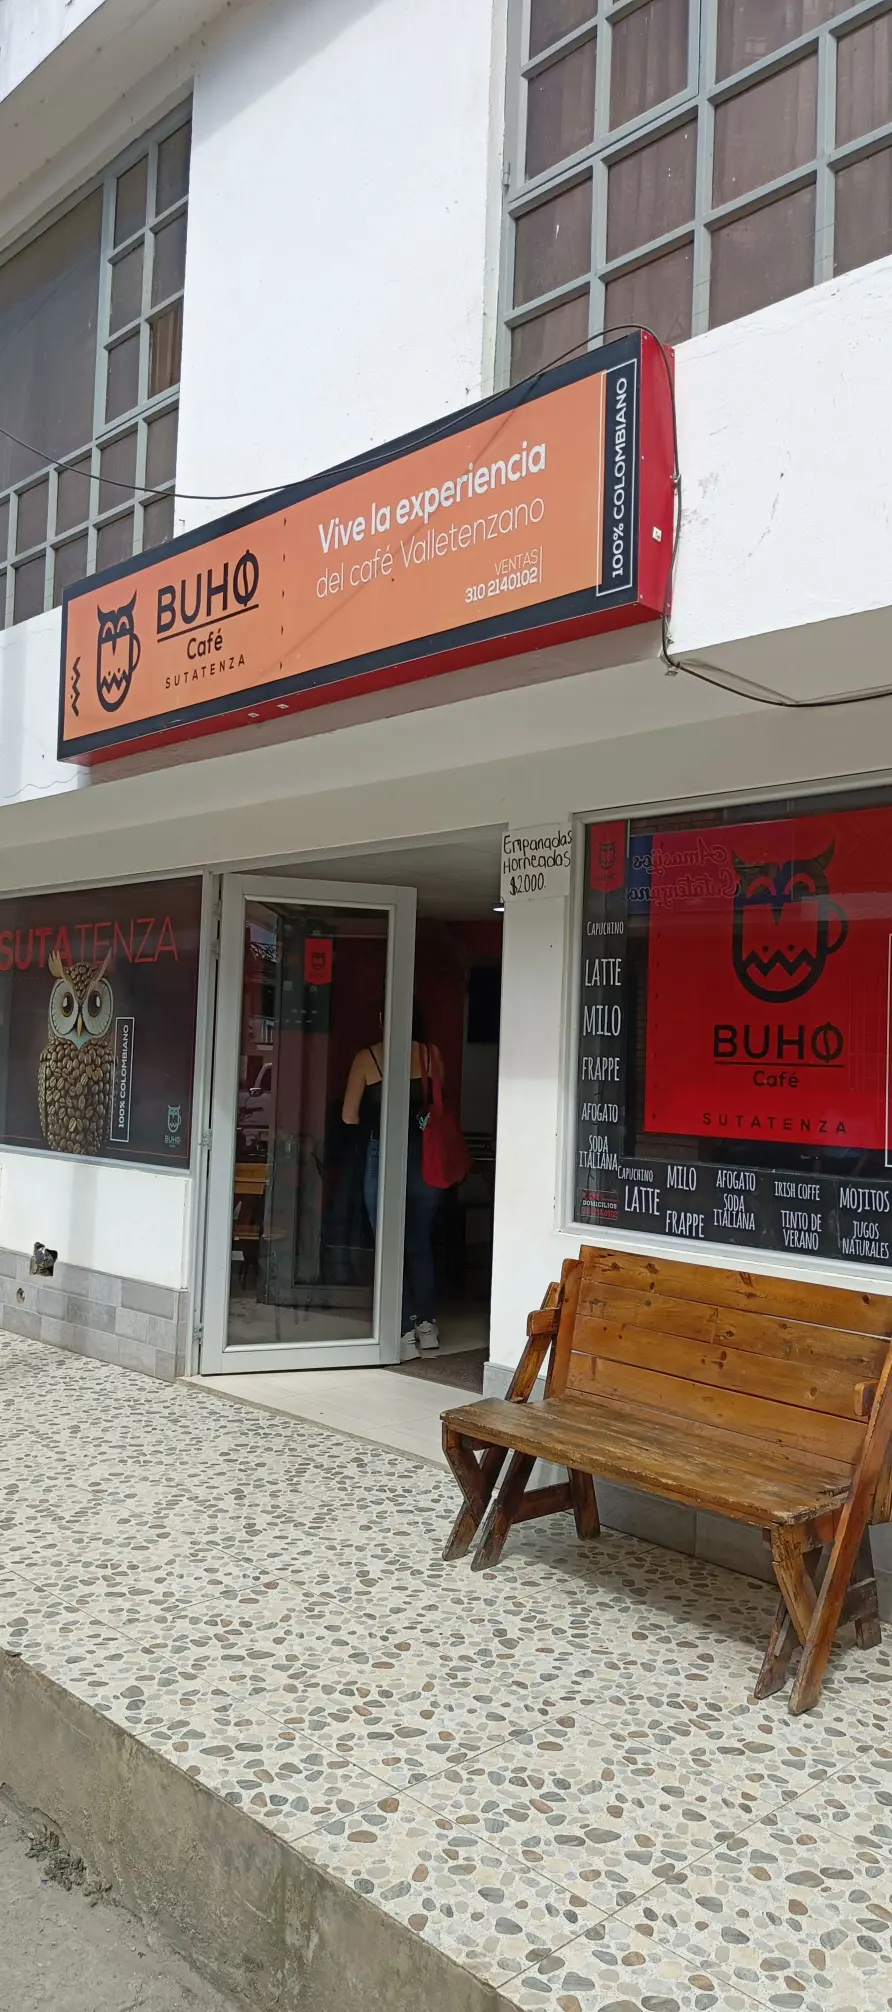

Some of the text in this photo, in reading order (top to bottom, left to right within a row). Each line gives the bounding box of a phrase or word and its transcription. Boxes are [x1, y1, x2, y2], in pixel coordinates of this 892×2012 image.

[611, 377, 627, 578] 100% COLOMBIANO
[318, 440, 546, 554] Vive la experiencia
[316, 498, 545, 598] del café Valletenzano
[494, 549, 539, 576] VENTAS
[465, 566, 538, 604] 310 2140102
[186, 628, 223, 660] Café
[165, 654, 245, 689] SUTATENZA
[503, 829, 573, 857] Empanadas
[584, 958, 622, 987] LATTE
[583, 1004, 622, 1037] MILO
[118, 1024, 129, 1129] 100% COLOMBIANO
[582, 1056, 620, 1081] FRAPPE
[752, 1070, 799, 1088] Café
[581, 1102, 618, 1123] AFOGATO
[702, 1112, 847, 1135] SUTATENZA
[588, 1134, 609, 1154] SODA
[578, 1151, 618, 1172] ITALIANA
[667, 1165, 697, 1191] MILO
[716, 1169, 756, 1192] AFOGATO
[624, 1185, 660, 1216] LATTE
[723, 1194, 745, 1213] SODA
[774, 1181, 821, 1201] IRISH COFFE
[839, 1187, 891, 1213] MOJITOS
[582, 1199, 618, 1210] DOMICILIOS
[665, 1210, 704, 1238] FRAPPE
[713, 1209, 756, 1231] ITALIANA
[780, 1210, 822, 1232] TINTO DE
[852, 1220, 880, 1240] JUGOS
[782, 1229, 819, 1251] VERANO
[842, 1237, 890, 1259] NATURALES
